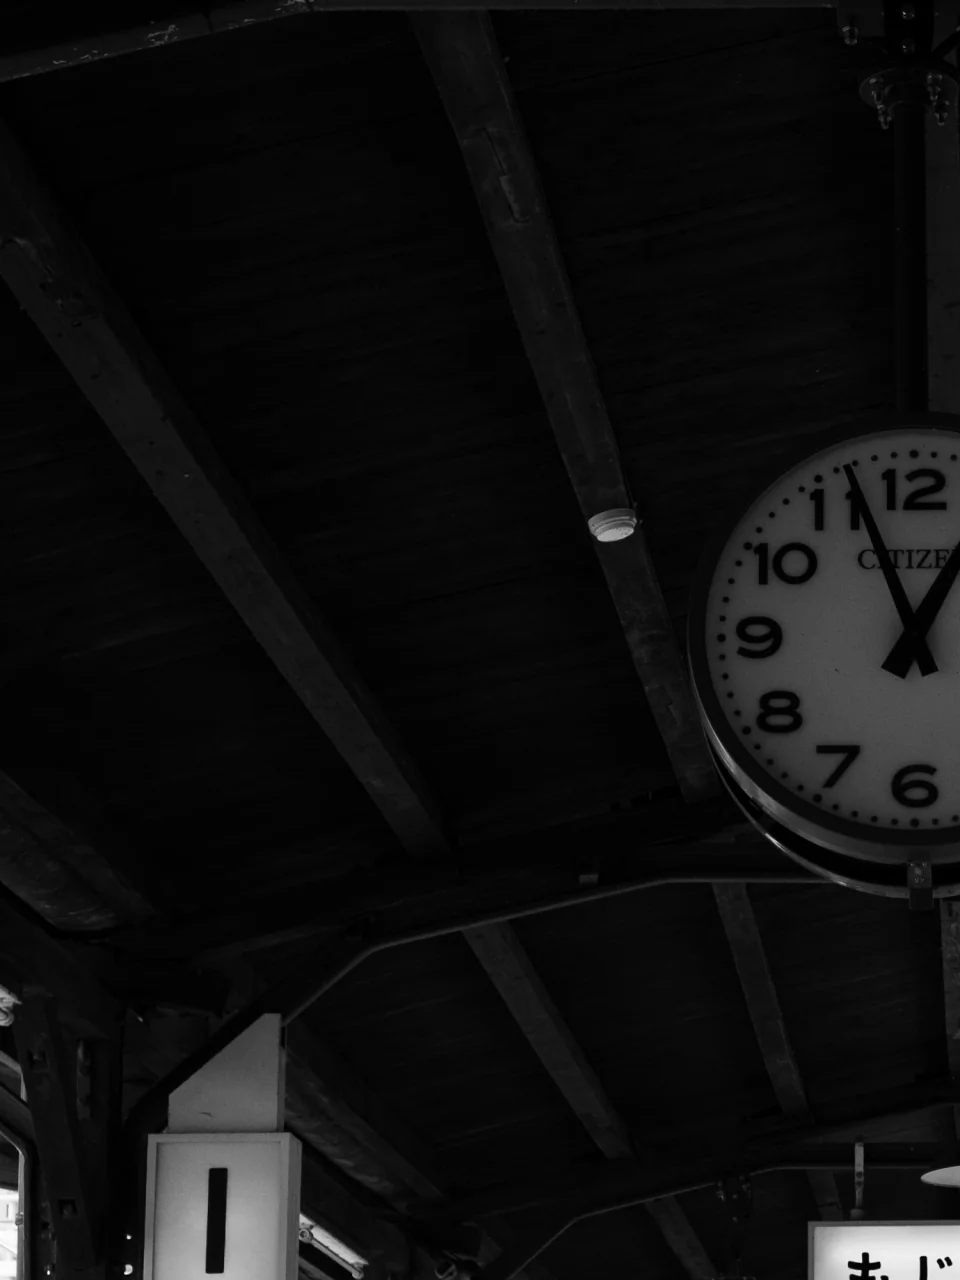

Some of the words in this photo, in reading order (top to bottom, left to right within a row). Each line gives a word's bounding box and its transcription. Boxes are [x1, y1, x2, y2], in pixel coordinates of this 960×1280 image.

[881, 468, 947, 510] 12
[754, 542, 818, 586] 10
[736, 616, 783, 659] 9
[756, 690, 803, 734] 8
[816, 745, 860, 788] 7
[891, 764, 939, 808] 6
[205, 1167, 228, 1274] 1
